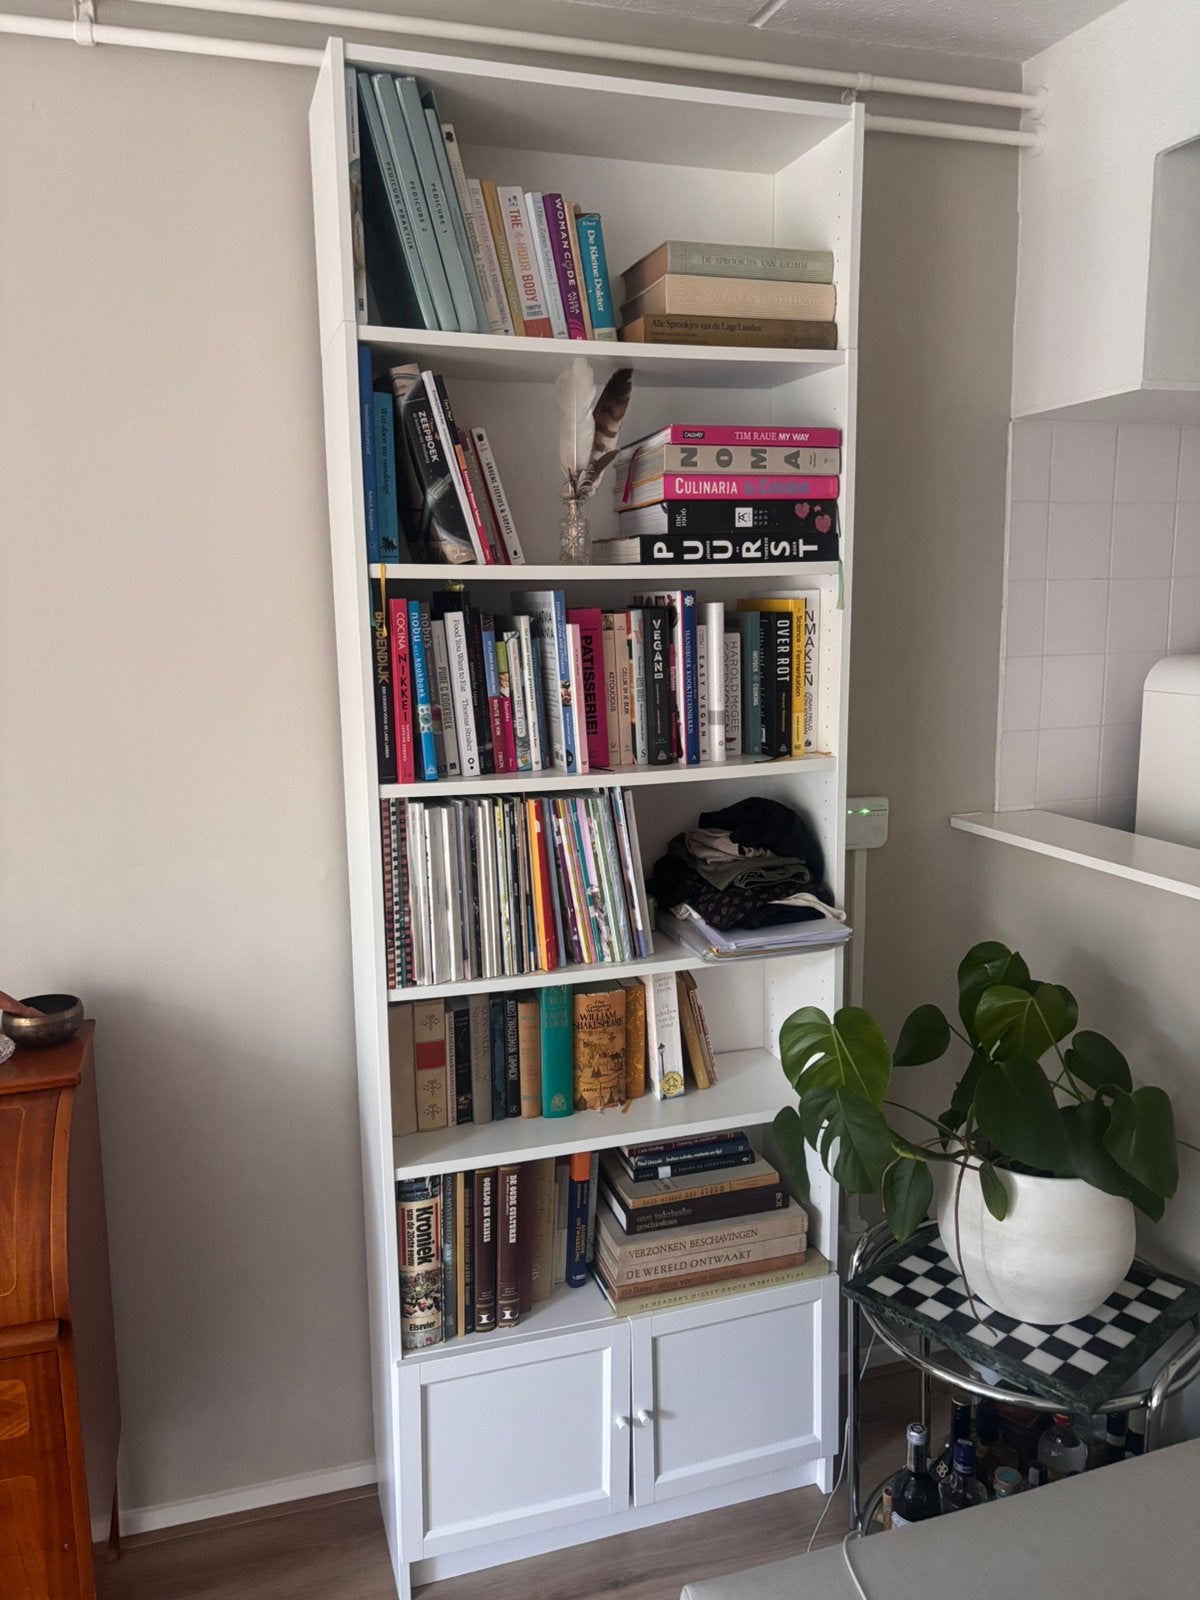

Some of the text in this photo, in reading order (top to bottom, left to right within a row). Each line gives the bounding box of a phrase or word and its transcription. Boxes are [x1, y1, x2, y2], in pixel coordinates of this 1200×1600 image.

[383, 161, 415, 250] PEDICURE PRAKTIJK
[405, 179, 428, 223] PEDICURE
[428, 182, 447, 225] PEDICURE
[554, 198, 568, 248] WOMAN
[539, 226, 549, 248] Zones
[507, 208, 538, 303] THE 4-HOUR BODY
[543, 249, 554, 279] Solution
[702, 256, 808, 269] DE SPROOKJES VAN GRIMM
[587, 229, 605, 311] De Kleine Dokter
[566, 293, 574, 313] VITTI
[571, 290, 579, 313] ALISA
[666, 321, 699, 330] Sprookjes
[722, 323, 737, 332] Lage
[380, 424, 388, 443] doen
[417, 409, 438, 463] ZEEPBOEK
[735, 432, 810, 441] TIM RAUE MY WAY
[381, 445, 387, 457] we
[680, 447, 800, 469] NOMA
[485, 461, 497, 483] GROENE
[492, 484, 504, 508] ZEEPJES
[500, 514, 512, 534] SOPJES
[653, 538, 818, 560] PUURST
[420, 612, 432, 648] nobu's
[452, 619, 460, 637] Food
[410, 611, 425, 697] nobu kookboek
[454, 638, 462, 652] You
[652, 619, 663, 672] VEGAN
[776, 619, 790, 681] OVER ROT
[395, 612, 409, 721] COCINA NIKKEI
[456, 653, 464, 671] Want
[794, 650, 802, 696] Fermentation
[437, 666, 448, 685] PURE
[458, 671, 464, 679] to
[580, 634, 598, 736] PATISSERIE!
[728, 640, 740, 731] HAROLD McGEE
[439, 692, 453, 729] KOOKBOEK
[461, 699, 470, 726] Thomas
[685, 670, 693, 733] KOOKTECHNIEKEN
[494, 717, 500, 726] DE
[464, 727, 473, 751] Straker
[506, 999, 515, 1016] JOOST
[580, 1010, 617, 1021] WILLIAM
[506, 1017, 516, 1052] ZWAGERMAN
[573, 1017, 623, 1030] SHAKESPEARE
[509, 1174, 516, 1184] DE
[406, 1209, 414, 1220] van
[482, 1177, 490, 1242] OORLOG EN CRISIS
[654, 1208, 692, 1219] vaderlandse
[406, 1221, 414, 1229] de
[415, 1206, 434, 1265] Kroniek
[637, 1219, 678, 1231] geschiedenis
[629, 1228, 759, 1259] VERZONKEN BESCHAVINGEN
[626, 1250, 752, 1280] DE WERELD ONTWAAKT
[652, 1296, 689, 1307] READER'S
[692, 1289, 719, 1299] DIGEST
[722, 1284, 747, 1293] GROTE
[750, 1272, 805, 1287] WERELDATLAS
[409, 1320, 436, 1331] Elsevier
